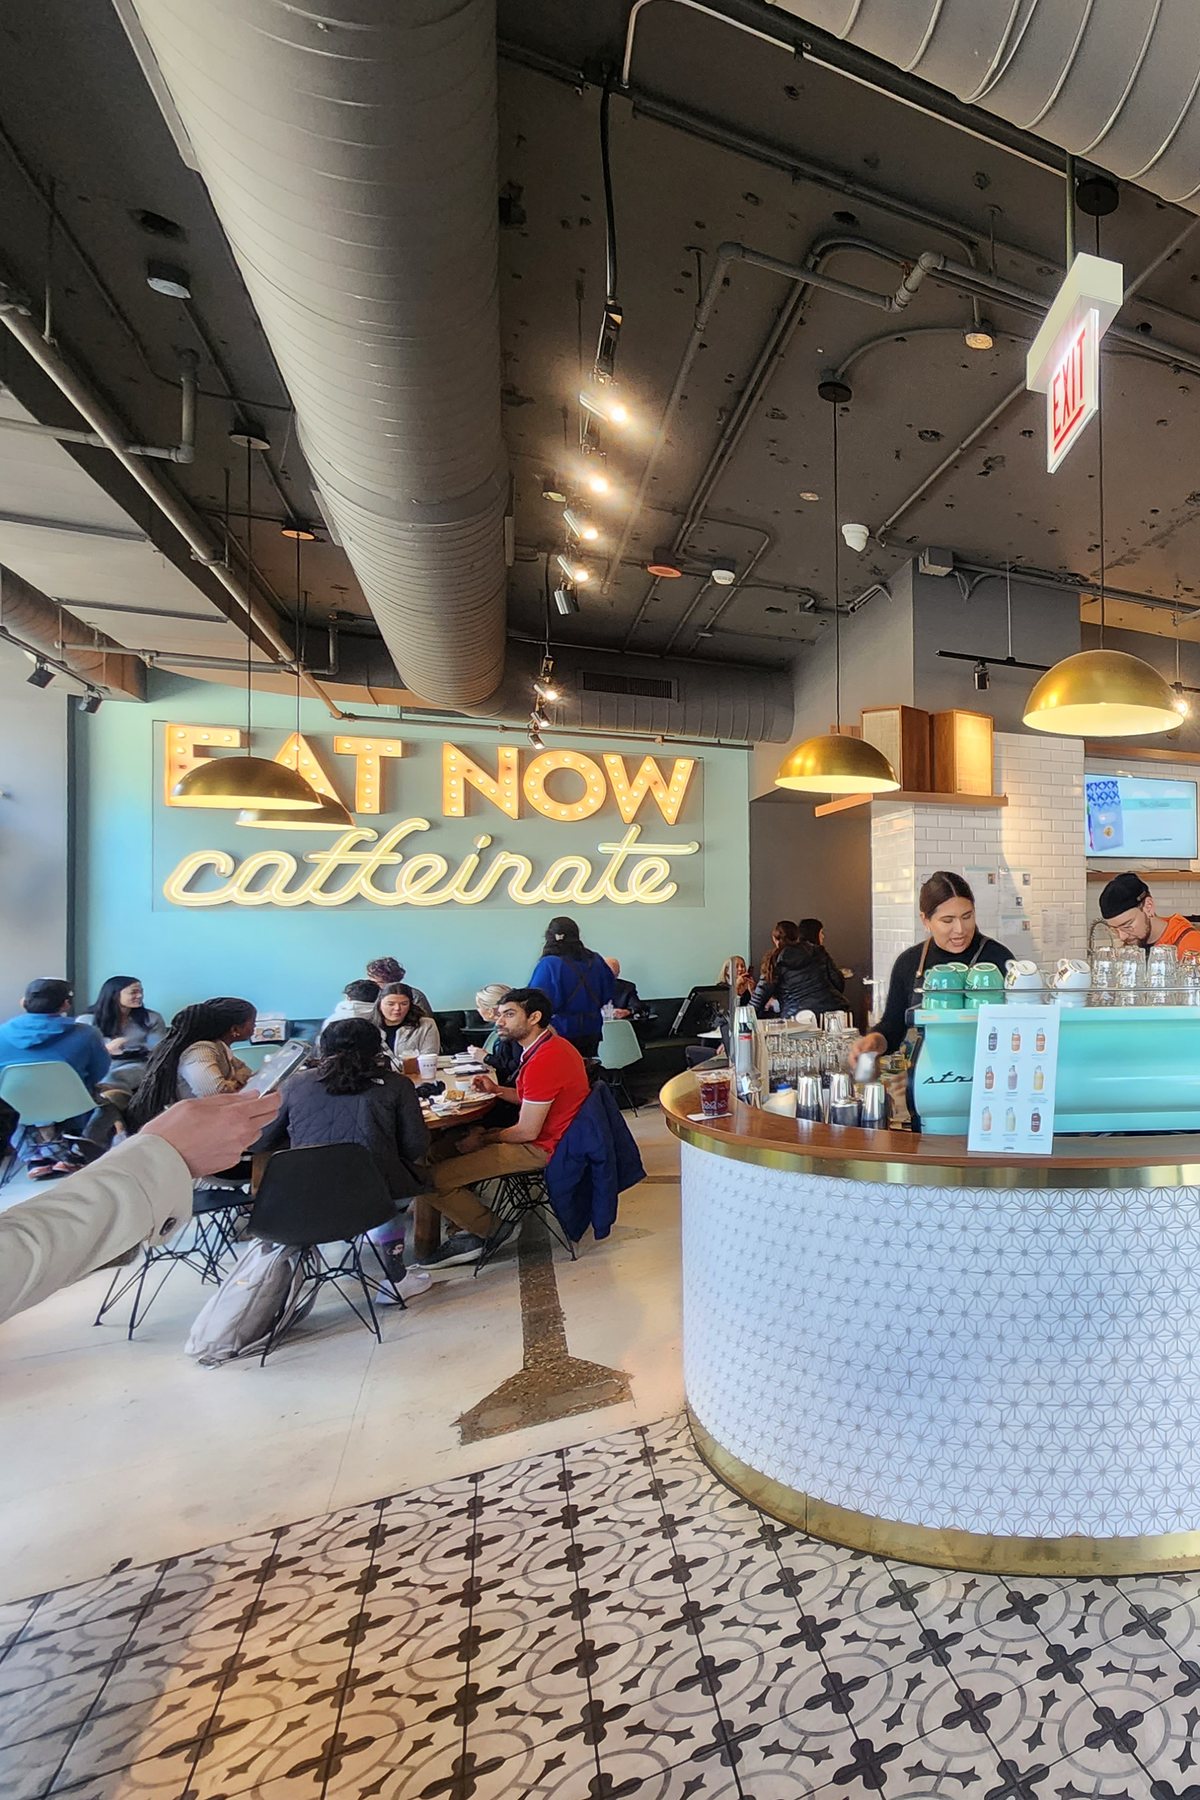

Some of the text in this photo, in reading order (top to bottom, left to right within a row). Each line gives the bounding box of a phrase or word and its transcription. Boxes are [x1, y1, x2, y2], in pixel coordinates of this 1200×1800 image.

[1053, 328, 1086, 441] EXIT
[165, 723, 695, 826] EAT NOW
[163, 818, 700, 907] caffeinate
